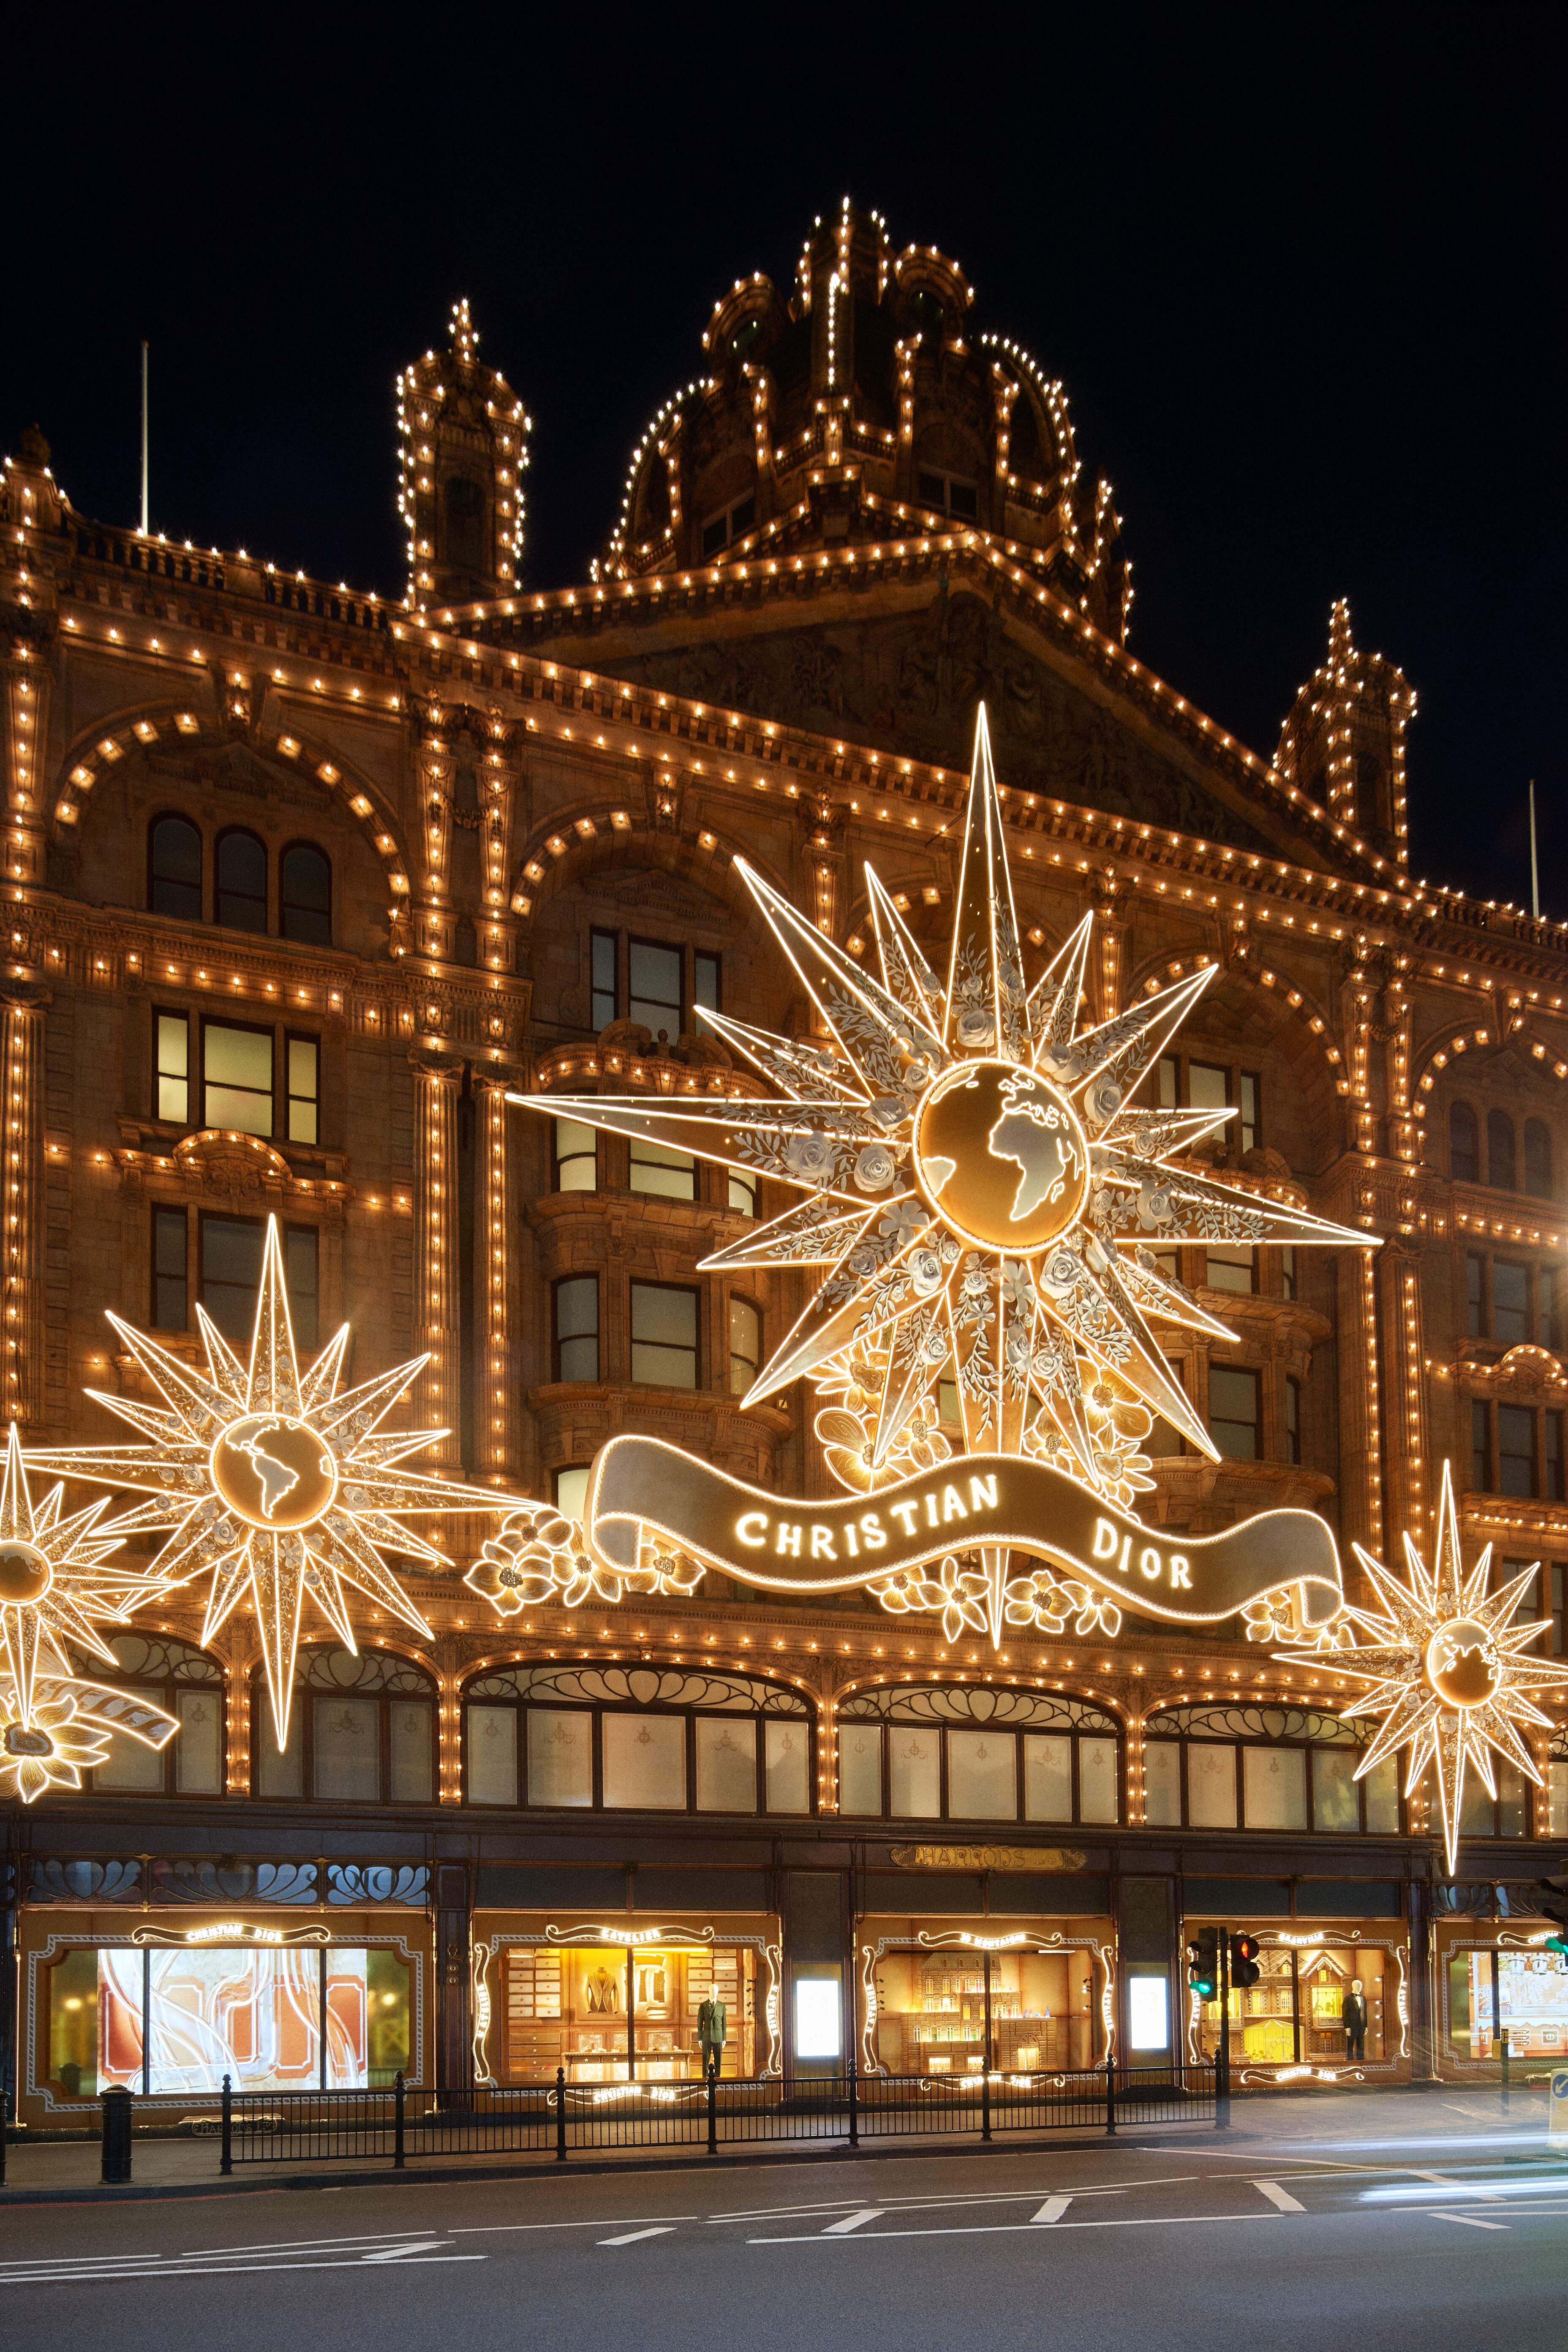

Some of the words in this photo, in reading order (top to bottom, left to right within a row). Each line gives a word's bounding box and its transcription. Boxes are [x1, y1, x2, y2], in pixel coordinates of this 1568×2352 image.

[735, 1473, 997, 1560] CHRISTIAN
[1092, 1516, 1193, 1589] DIOR
[920, 1848, 1025, 1867] HARRODS
[187, 1925, 242, 1941] CHRISTIAN
[253, 1928, 282, 1942] DIOR
[602, 1928, 661, 1943] L'ATELIER
[975, 1934, 1026, 1947] MONTAIGNE
[1279, 1933, 1324, 1944] GRANVILLE
[1276, 2067, 1312, 2081] CHRISTIAN
[1318, 2070, 1336, 2080] DIOR
[594, 2085, 642, 2102] CHRISTIAN
[651, 2088, 675, 2101] DIOR
